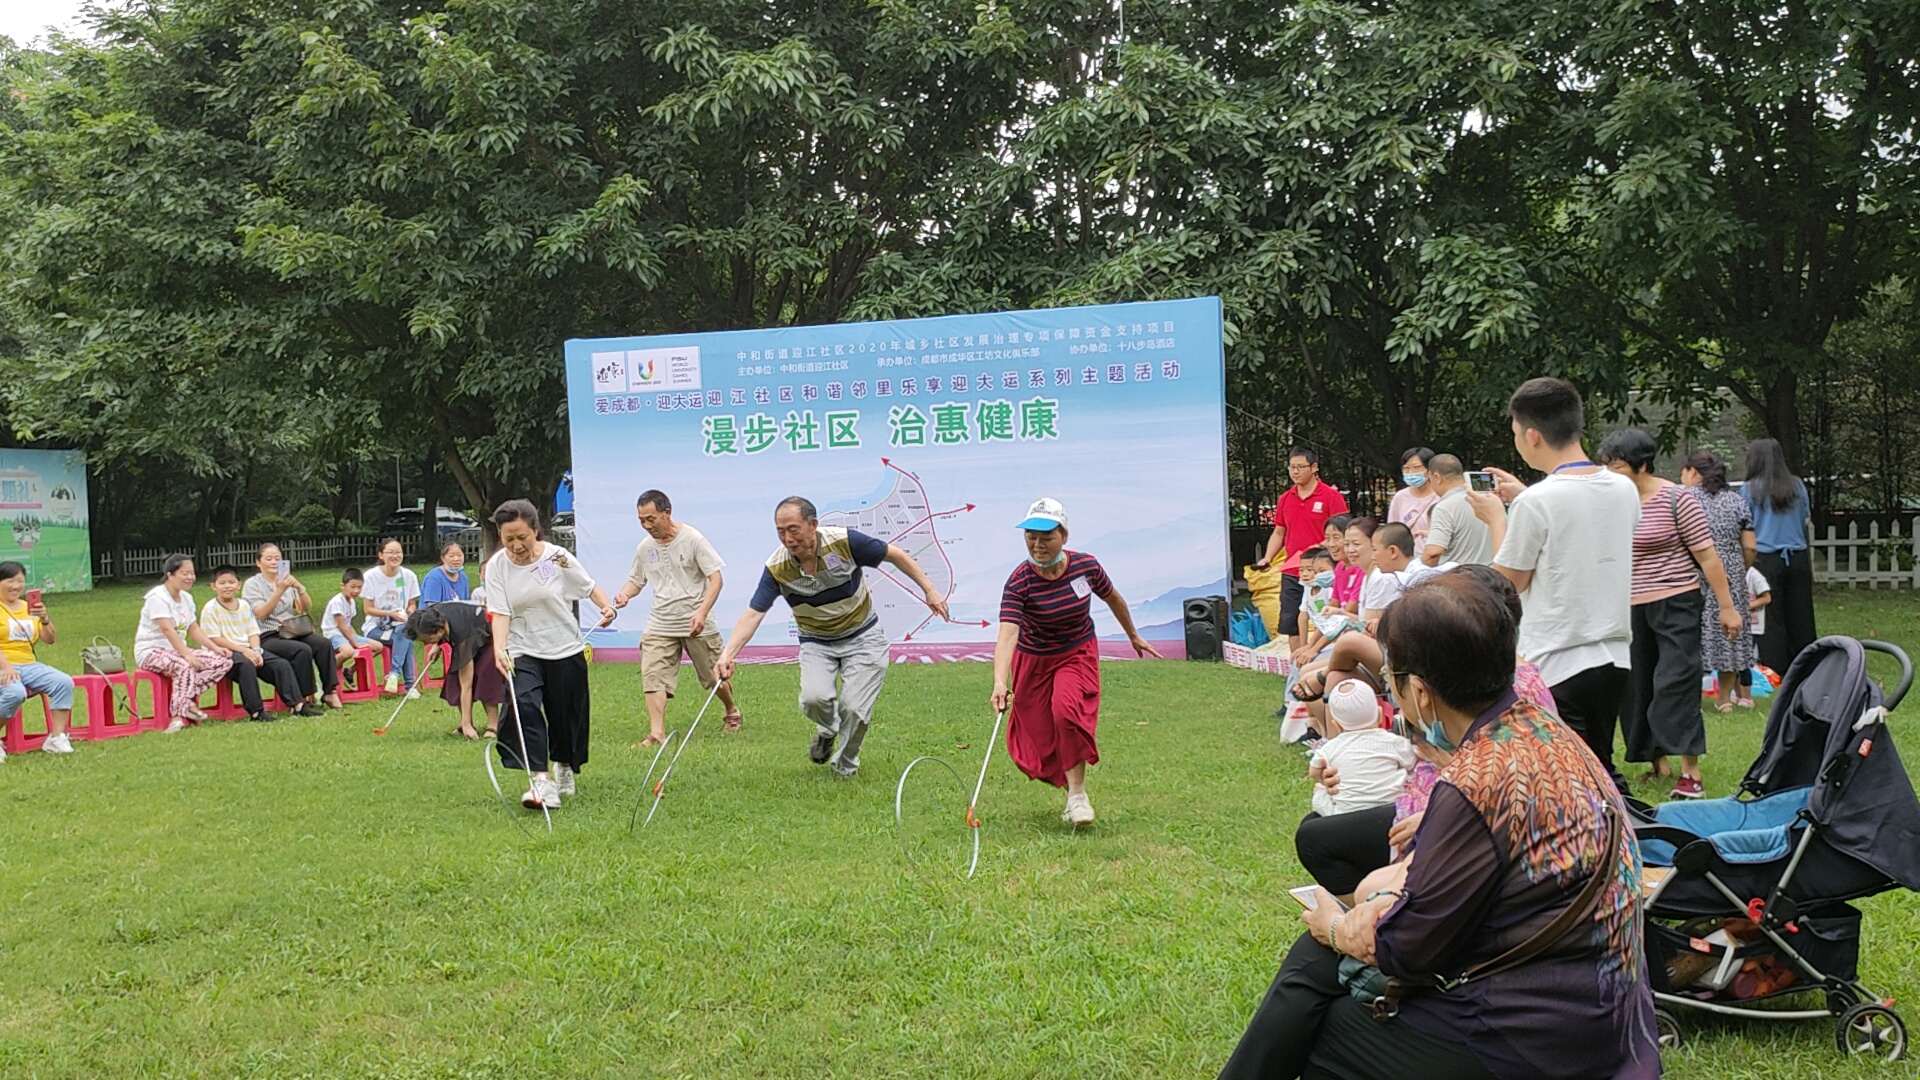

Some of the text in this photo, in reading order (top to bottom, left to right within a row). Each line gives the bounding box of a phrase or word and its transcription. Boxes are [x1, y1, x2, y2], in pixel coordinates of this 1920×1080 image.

[736, 321, 1175, 362] 中和街道迎江社区2020年城乡社区发展治理专项保障资金支持项目
[703, 398, 1058, 455] 漫步社区 治惠健康
